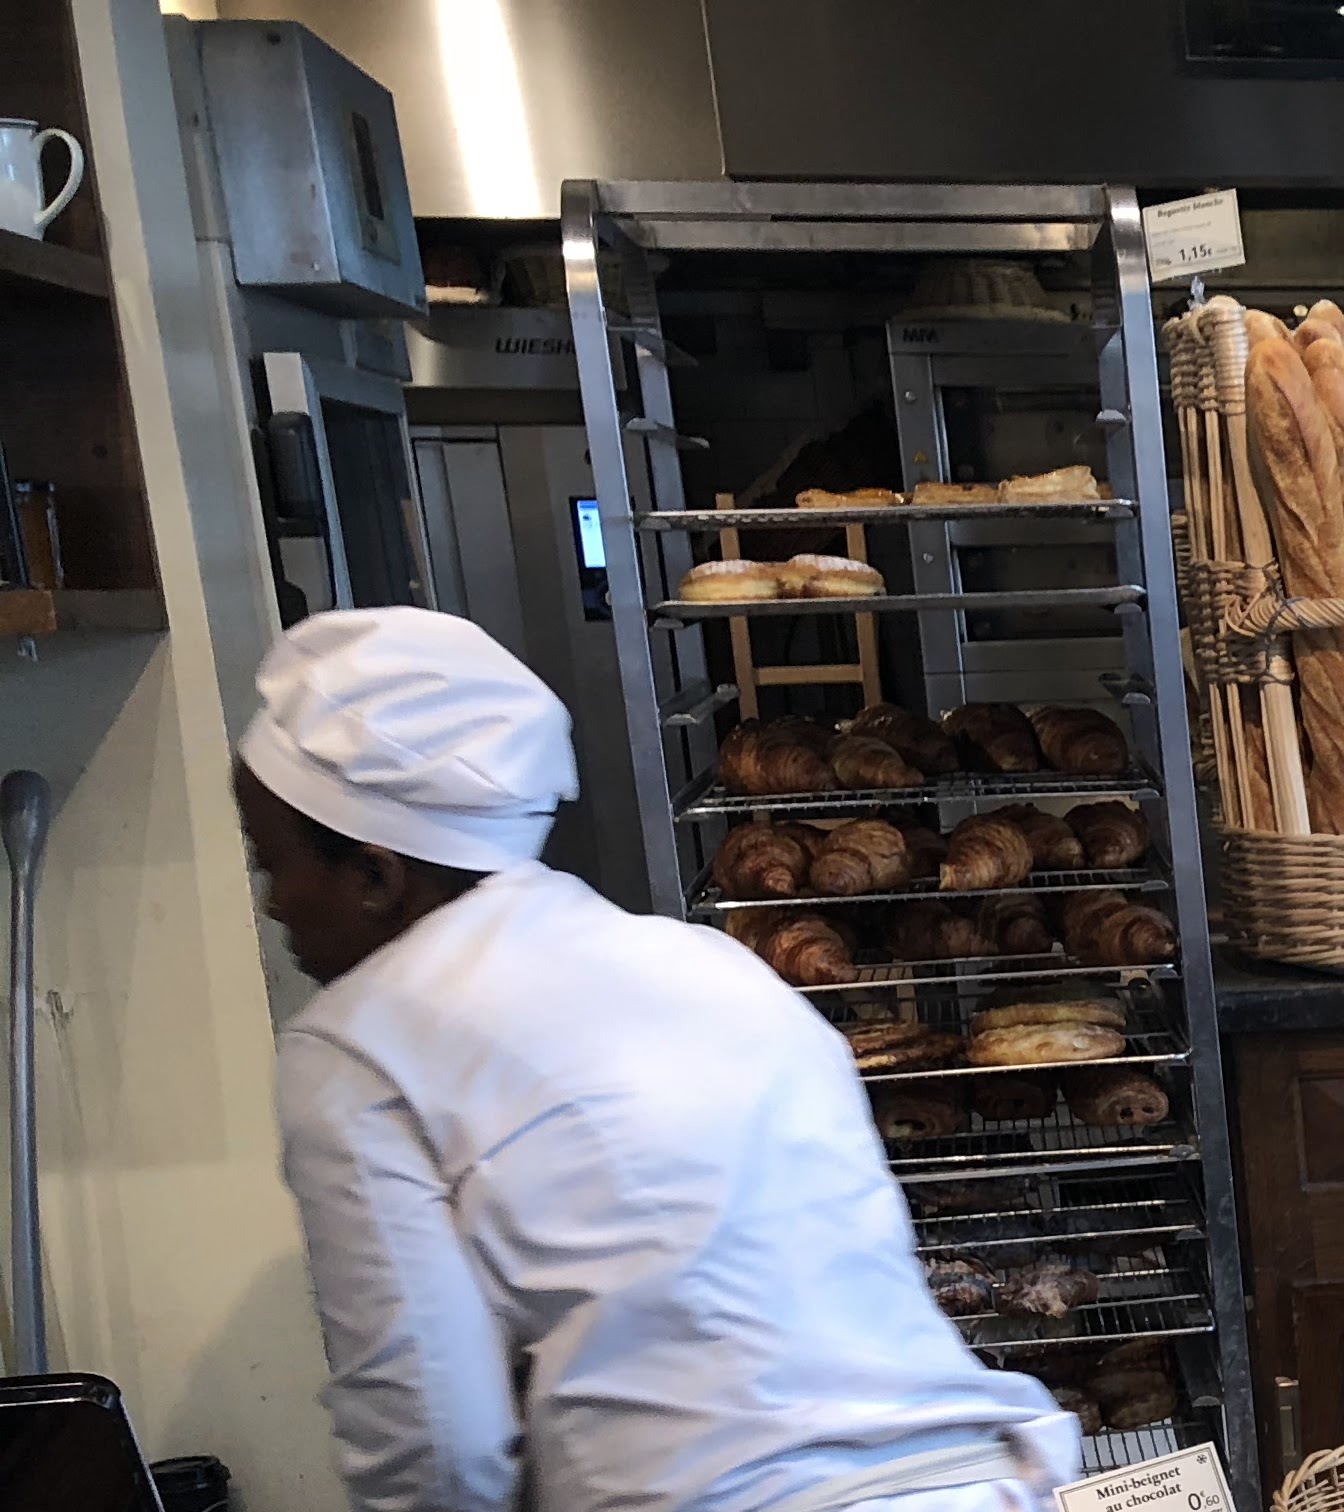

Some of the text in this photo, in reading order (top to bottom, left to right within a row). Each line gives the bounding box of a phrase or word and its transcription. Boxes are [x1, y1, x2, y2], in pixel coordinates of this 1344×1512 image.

[1180, 244, 1212, 261] 1,15€
[1096, 1466, 1181, 1500] Mini-beignet
[1126, 1482, 1182, 1508] chocolat
